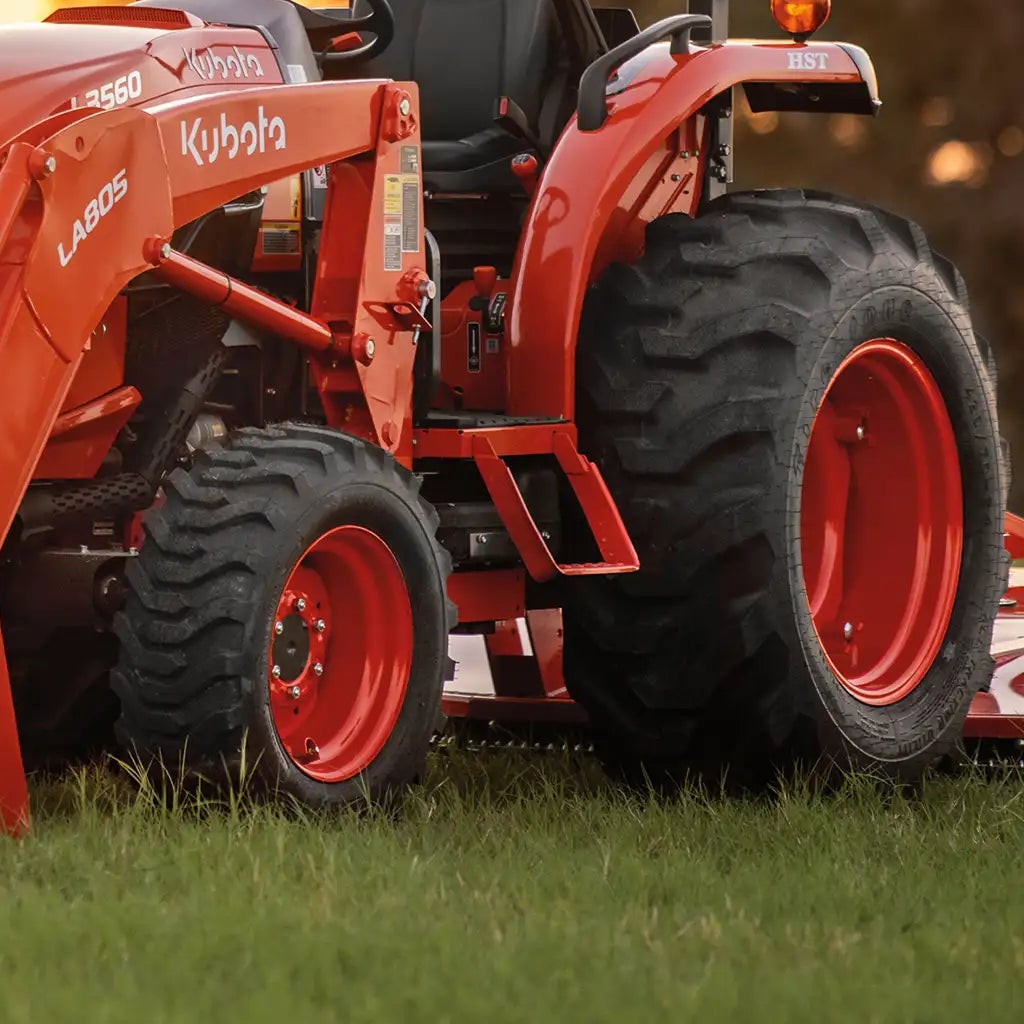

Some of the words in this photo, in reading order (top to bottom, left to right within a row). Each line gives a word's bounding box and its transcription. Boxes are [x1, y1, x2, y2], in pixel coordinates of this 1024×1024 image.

[182, 46, 264, 79] Kubota
[787, 52, 828, 70] HST
[180, 105, 286, 166] Kubota
[57, 168, 128, 267] LA805
